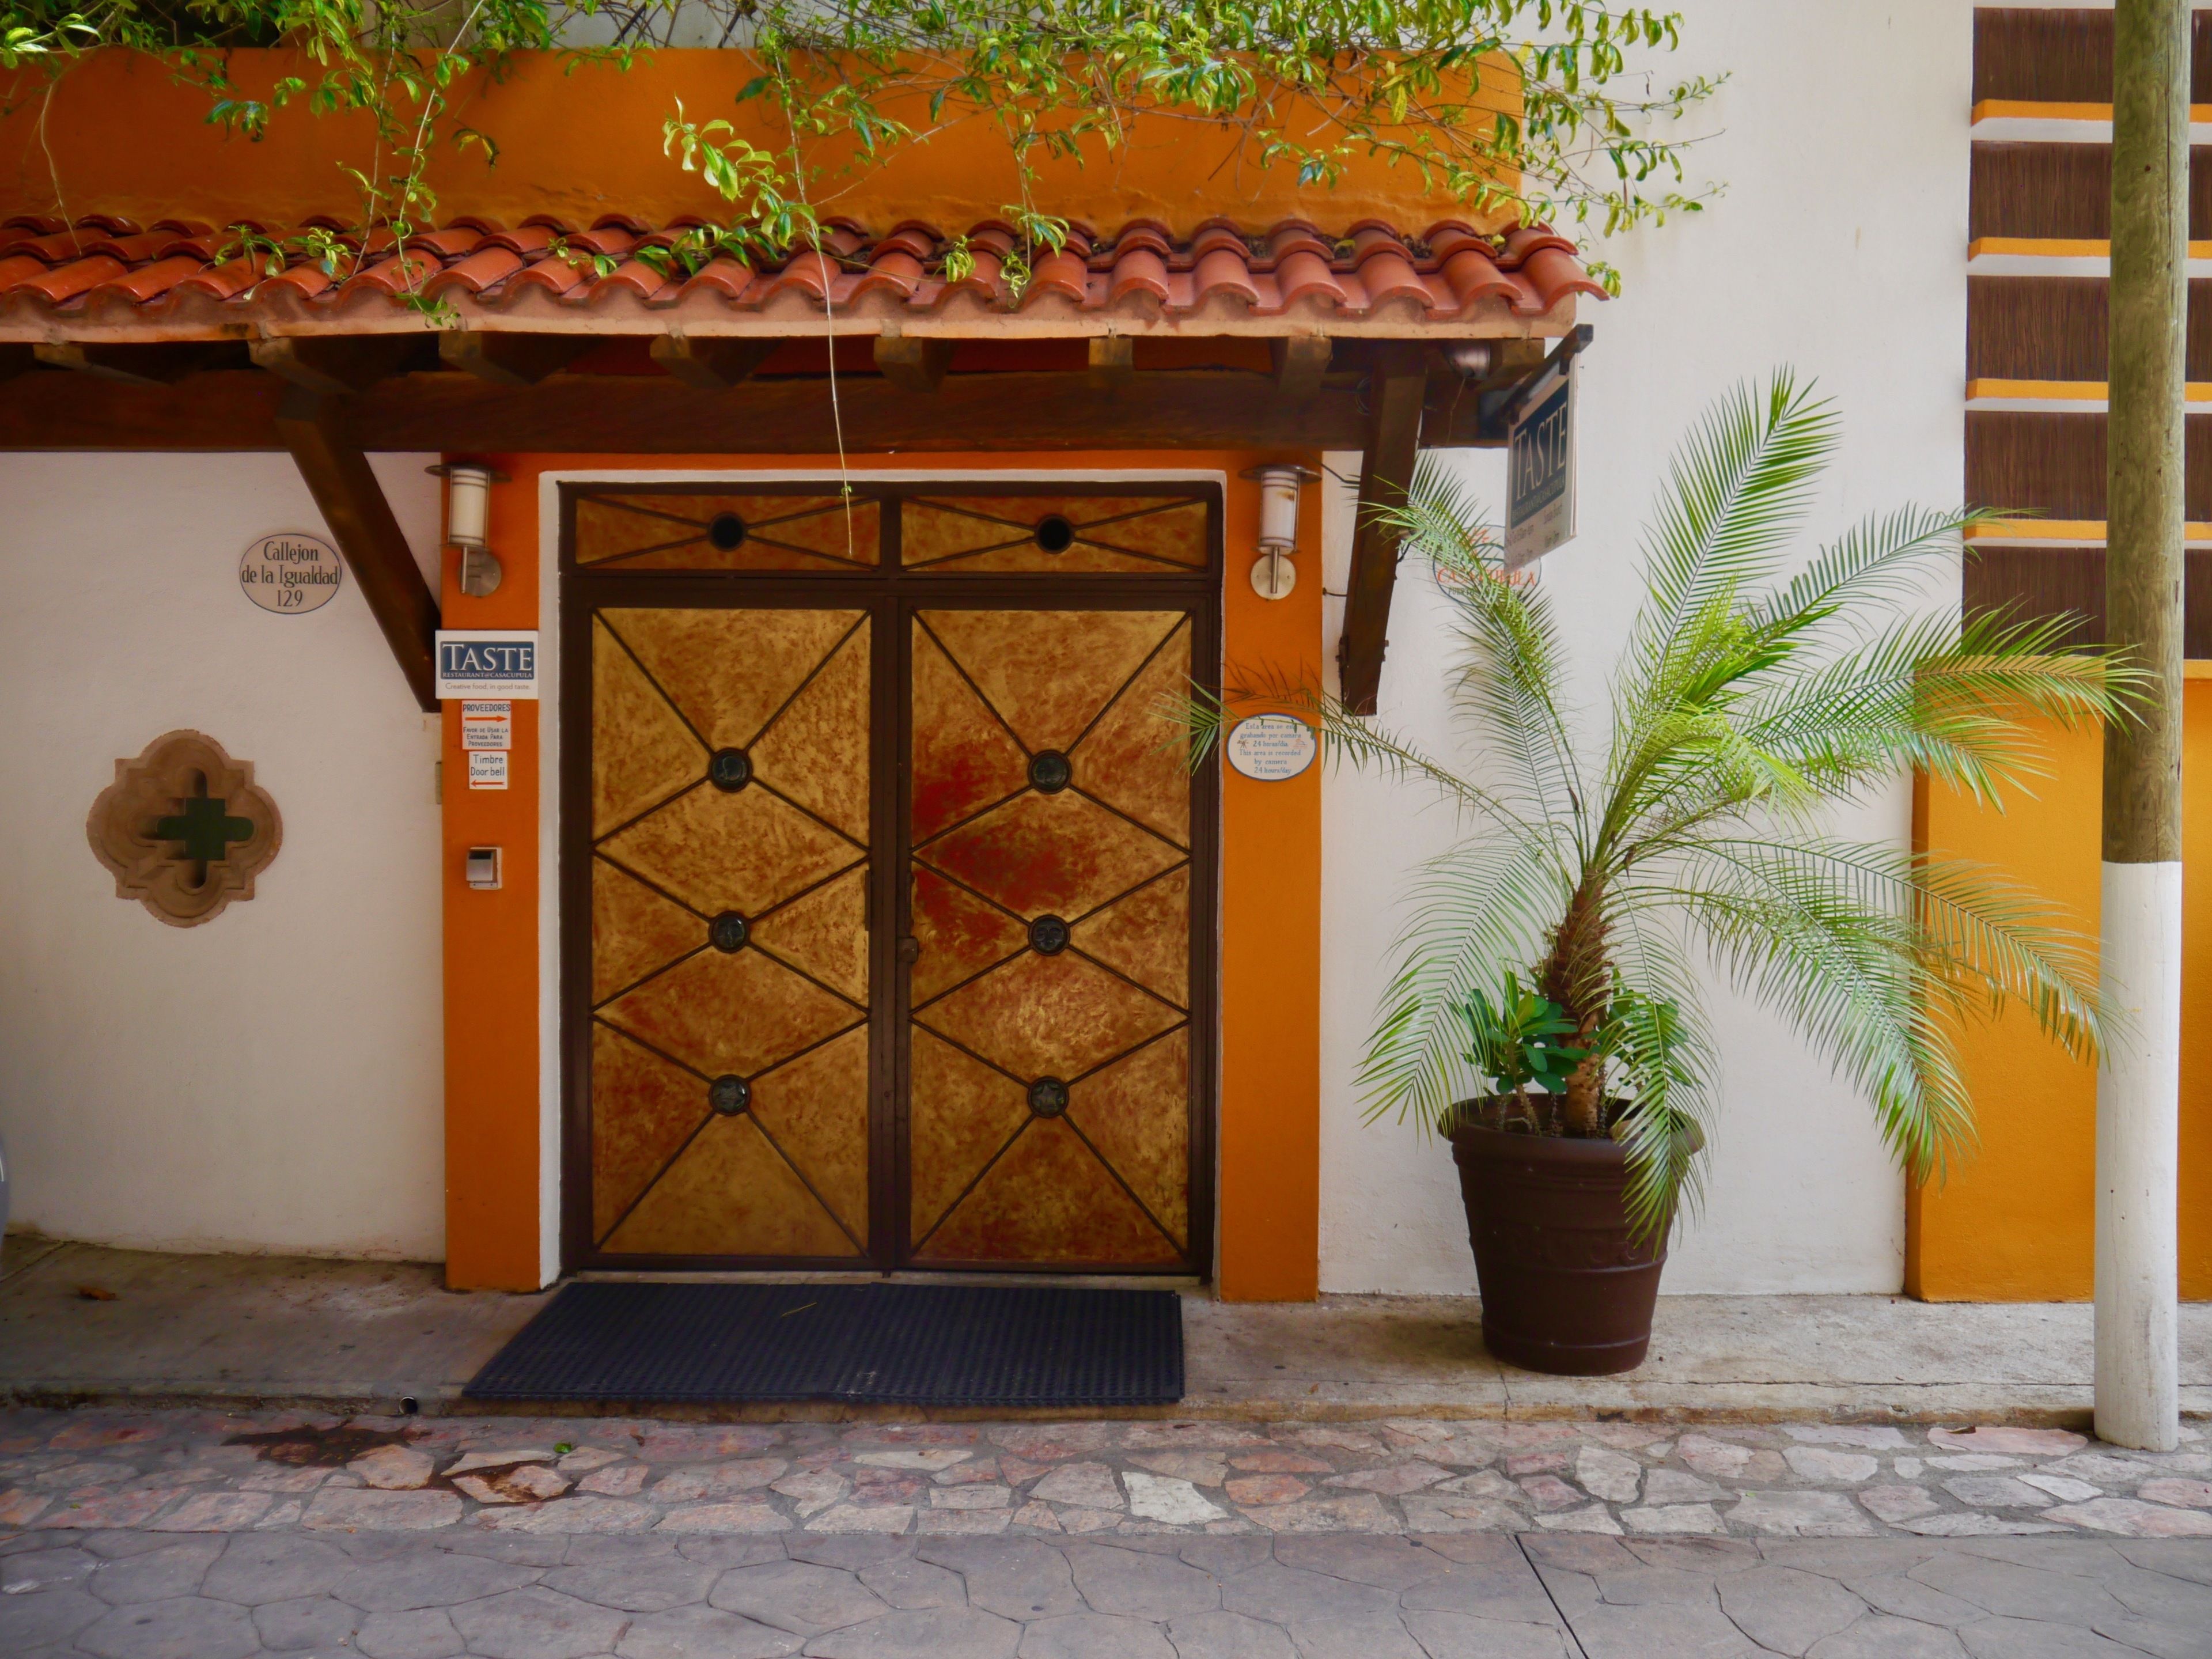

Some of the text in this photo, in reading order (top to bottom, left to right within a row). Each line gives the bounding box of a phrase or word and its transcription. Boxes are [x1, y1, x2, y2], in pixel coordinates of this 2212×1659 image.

[1514, 403, 1567, 501] TASTE
[263, 541, 319, 565] Callejon
[241, 565, 338, 588] de la Igualdad
[277, 590, 303, 607] 129
[442, 644, 532, 671] TASTE
[497, 682, 513, 691] good
[463, 704, 511, 712] PROVEEDORES
[474, 754, 503, 764] Timbre
